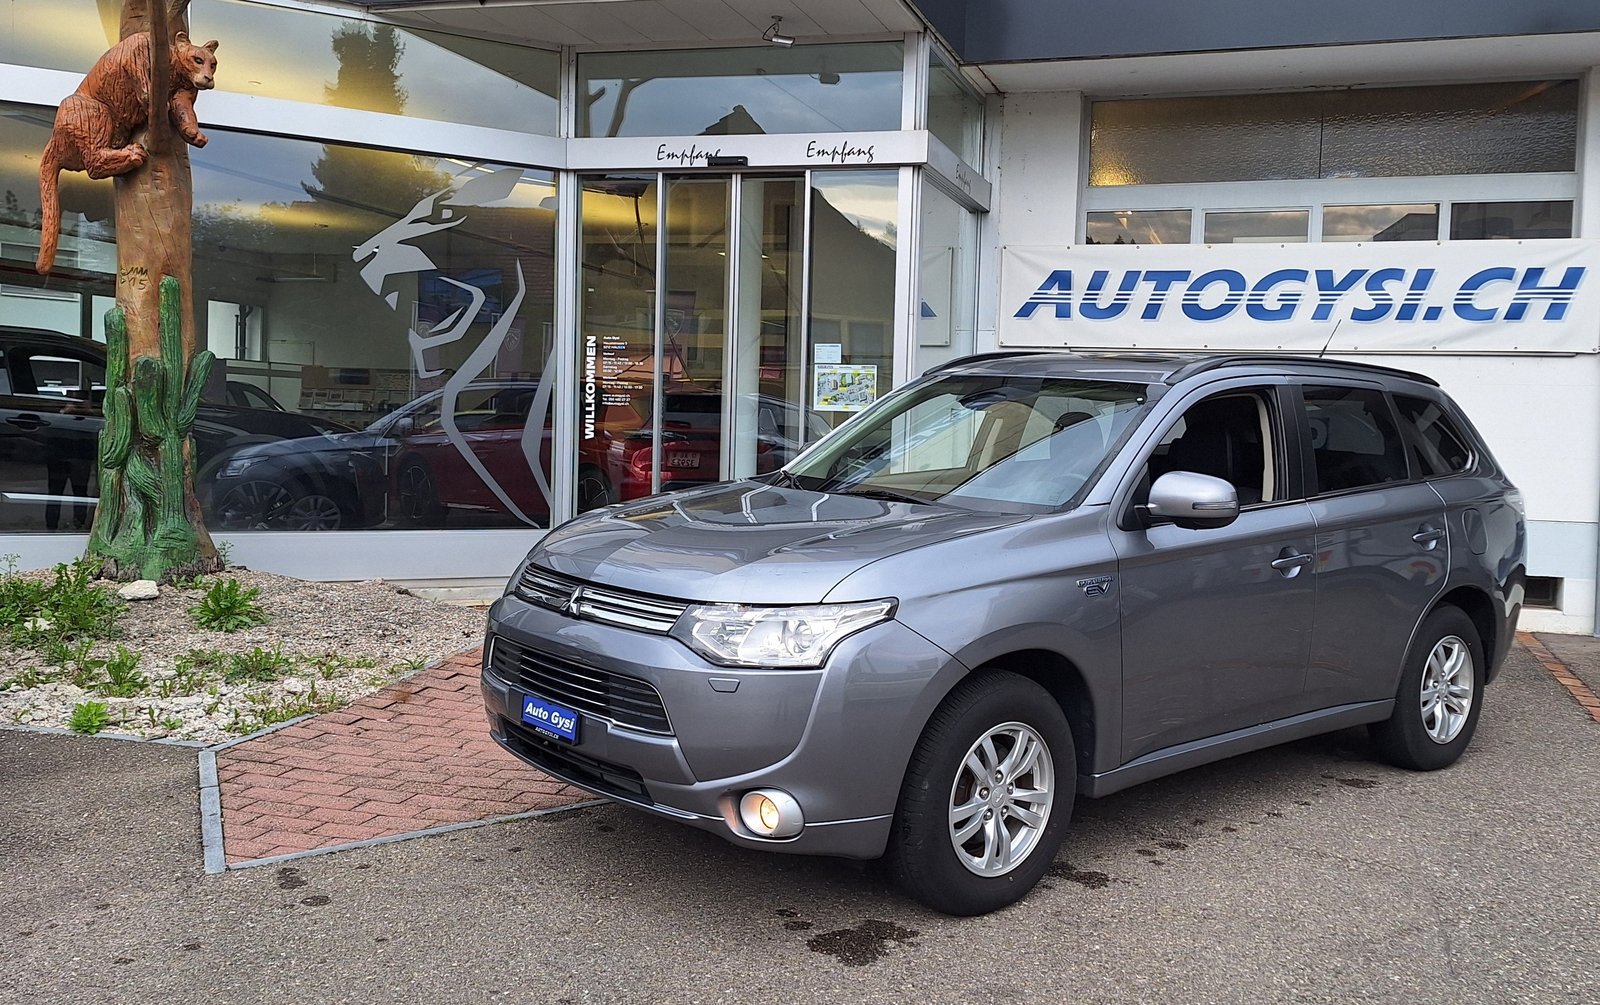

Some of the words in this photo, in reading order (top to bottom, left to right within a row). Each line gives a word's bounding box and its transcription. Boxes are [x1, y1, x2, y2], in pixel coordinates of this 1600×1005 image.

[806, 140, 875, 163] Empfang
[1013, 266, 1587, 322] AUTOGYSI.CH
[585, 335, 597, 440] WILLKOMMEN
[1084, 582, 1111, 597] EV
[525, 702, 548, 719] Auto
[551, 711, 575, 729] Gysi
